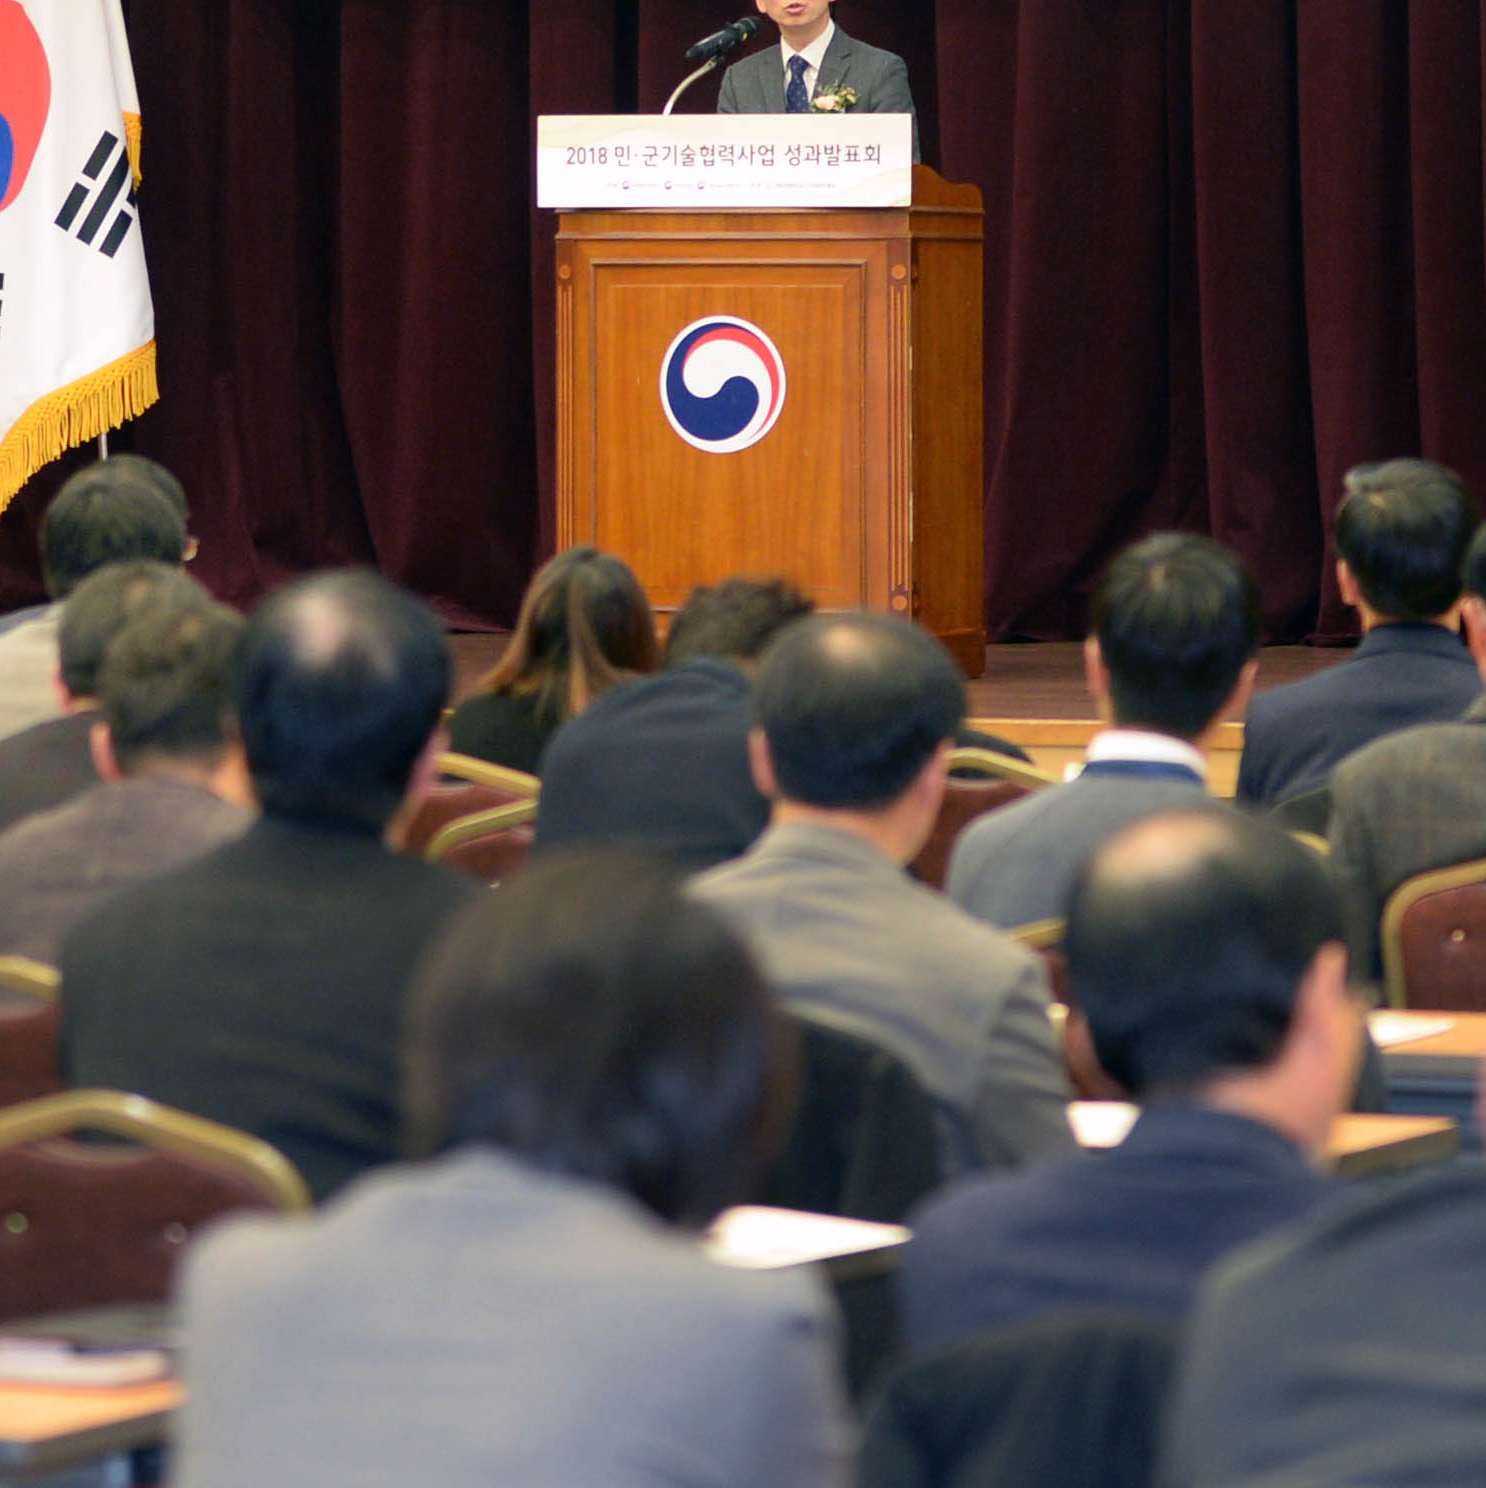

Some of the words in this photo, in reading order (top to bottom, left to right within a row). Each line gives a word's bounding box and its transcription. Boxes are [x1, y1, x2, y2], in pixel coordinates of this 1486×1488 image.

[566, 146, 608, 166] 2018
[614, 143, 776, 167] 민·군기술협력사업
[784, 143, 881, 167] 성과발표회
